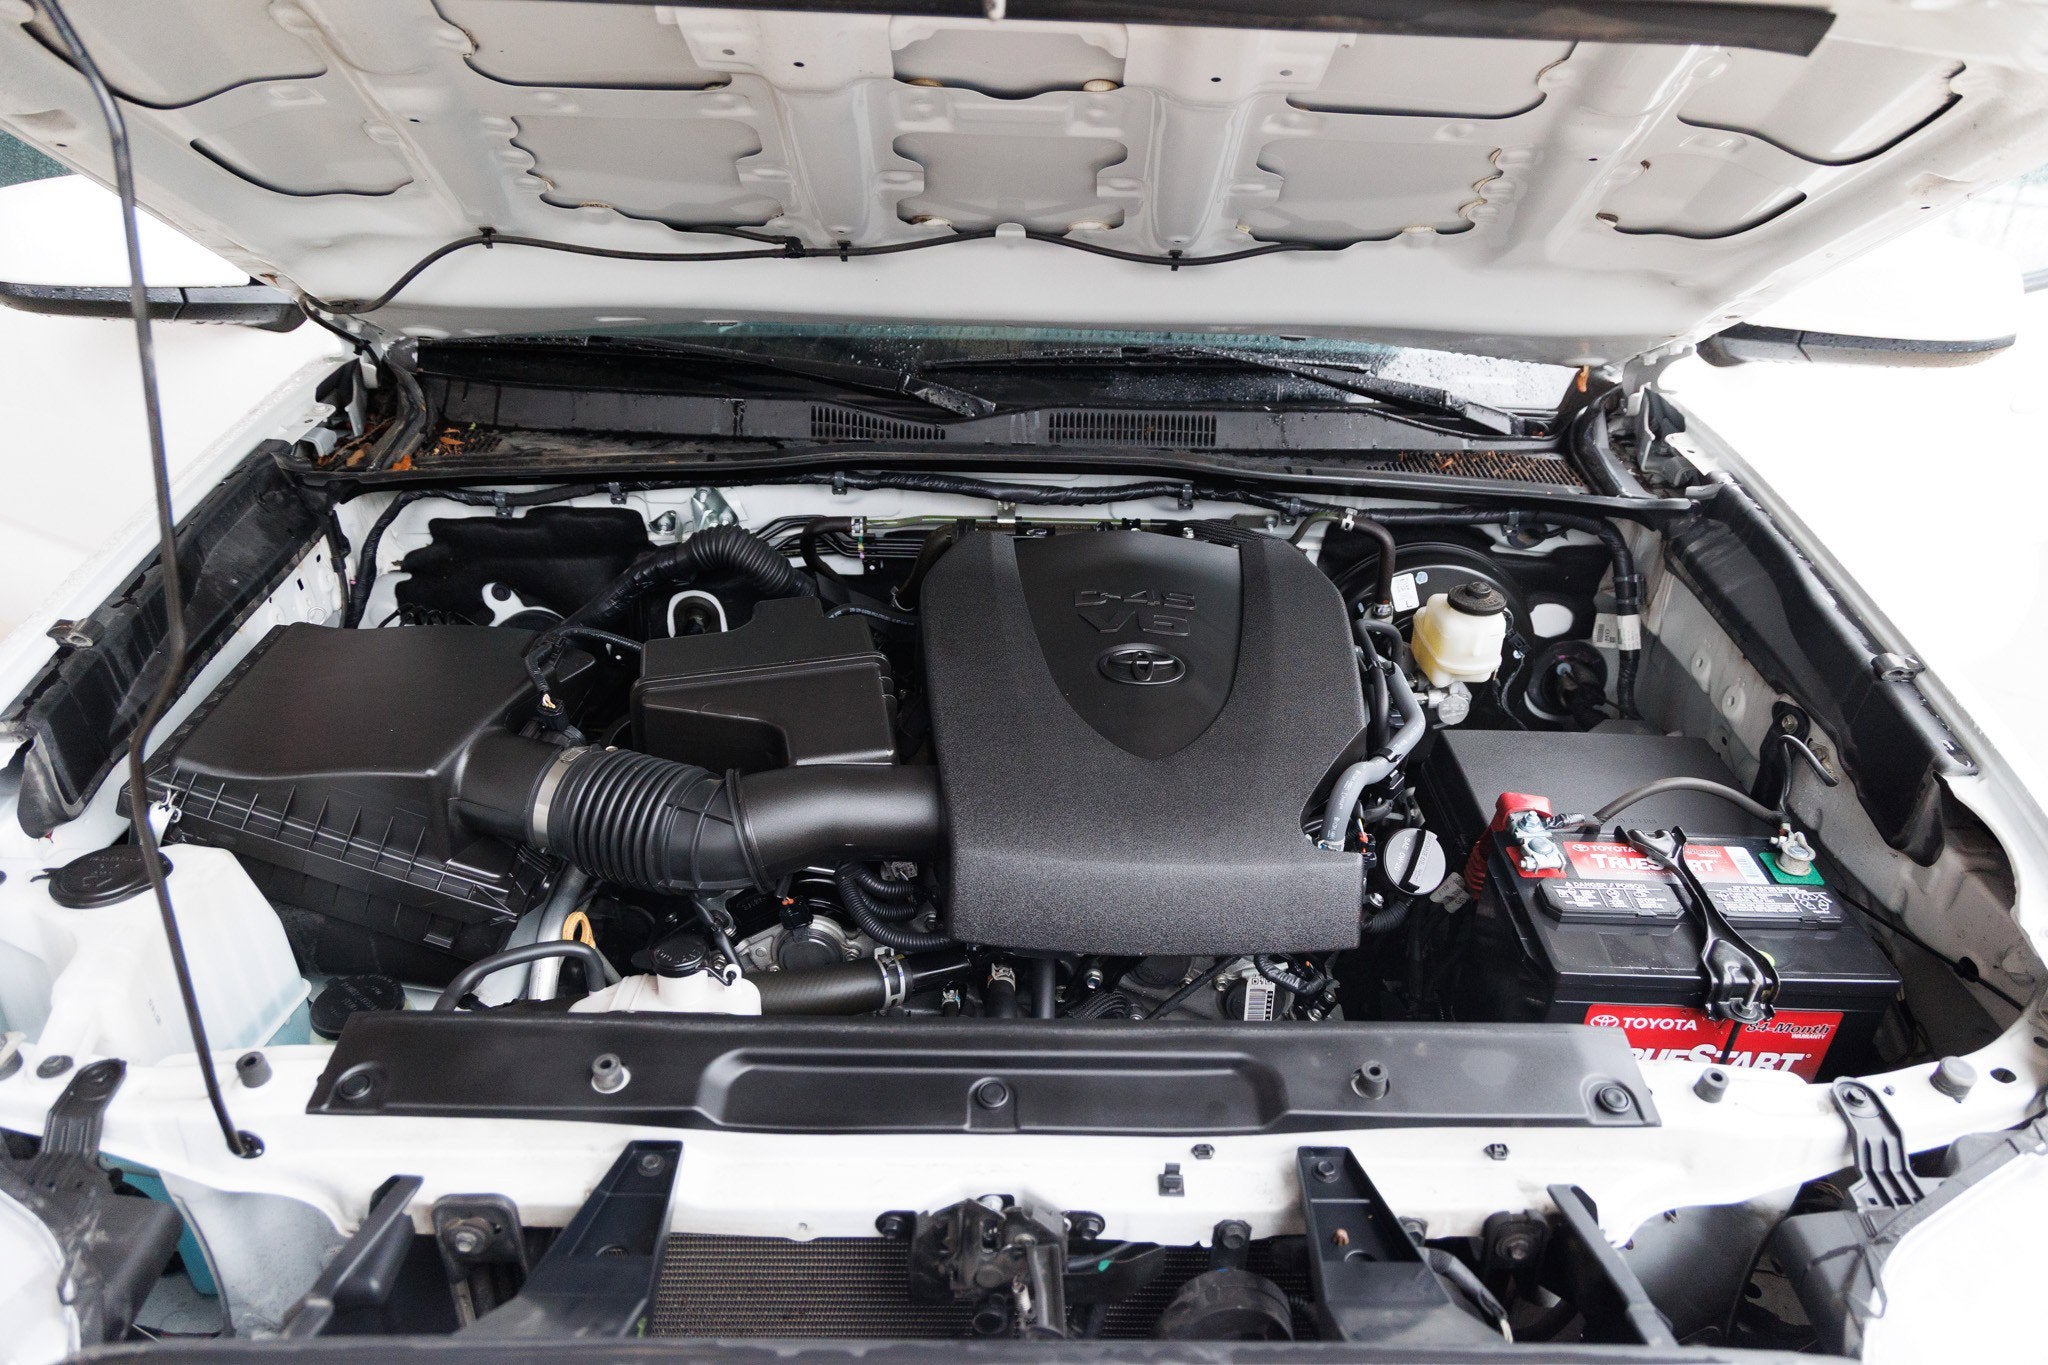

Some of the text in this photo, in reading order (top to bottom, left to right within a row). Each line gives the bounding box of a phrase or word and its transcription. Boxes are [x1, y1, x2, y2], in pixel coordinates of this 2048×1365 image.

[1077, 608, 1191, 637] V6
[1590, 845, 1638, 853] TOYOTA
[1590, 853, 1714, 871] TRUESRT
[1622, 1017, 1698, 1031] TOYOTA
[1745, 1021, 1831, 1035] 84-Month
[1631, 1043, 1805, 1073] RUESART
